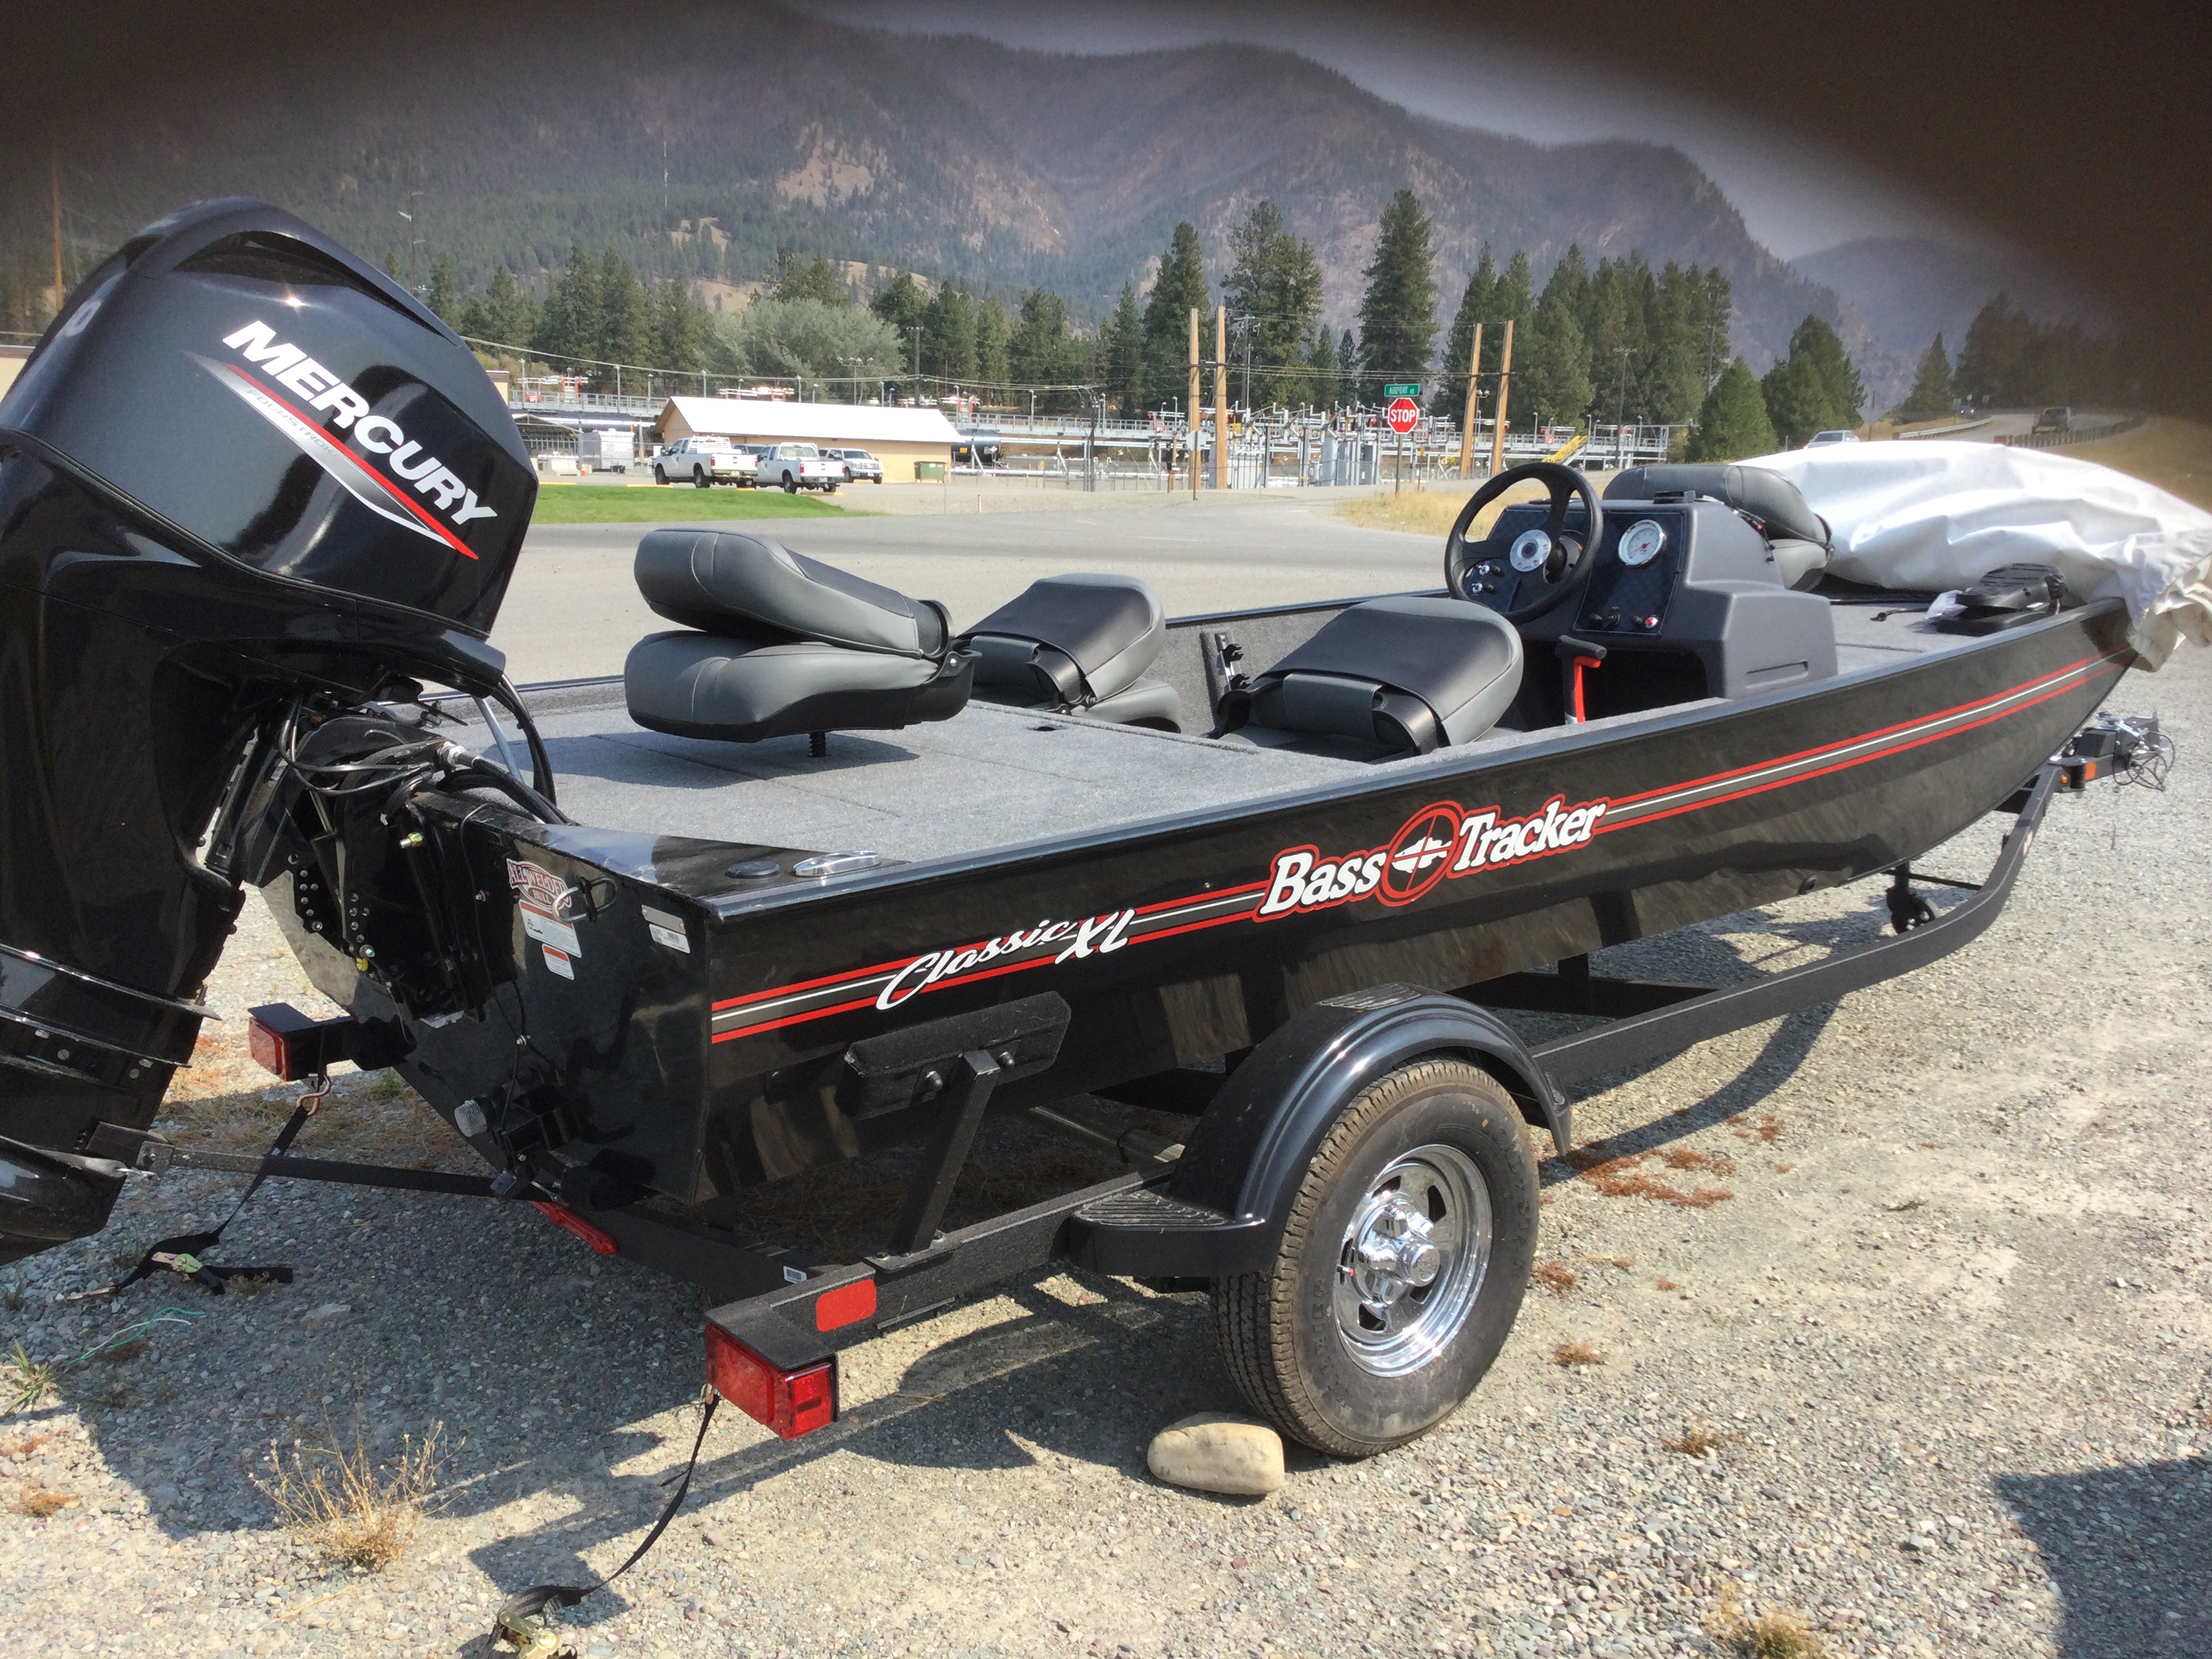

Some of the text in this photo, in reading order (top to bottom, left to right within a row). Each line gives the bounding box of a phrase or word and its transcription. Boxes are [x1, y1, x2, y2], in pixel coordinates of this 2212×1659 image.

[1389, 386, 1408, 394] AIRPORT
[1390, 409, 1416, 422] STOP
[222, 320, 498, 525] MERCURY
[247, 388, 343, 461] FOURSTROKE
[510, 862, 570, 897] ALL WELDED
[1259, 800, 1607, 915] Bass Tracker
[532, 889, 552, 905] HULL
[876, 908, 1137, 1010] Classic XL
